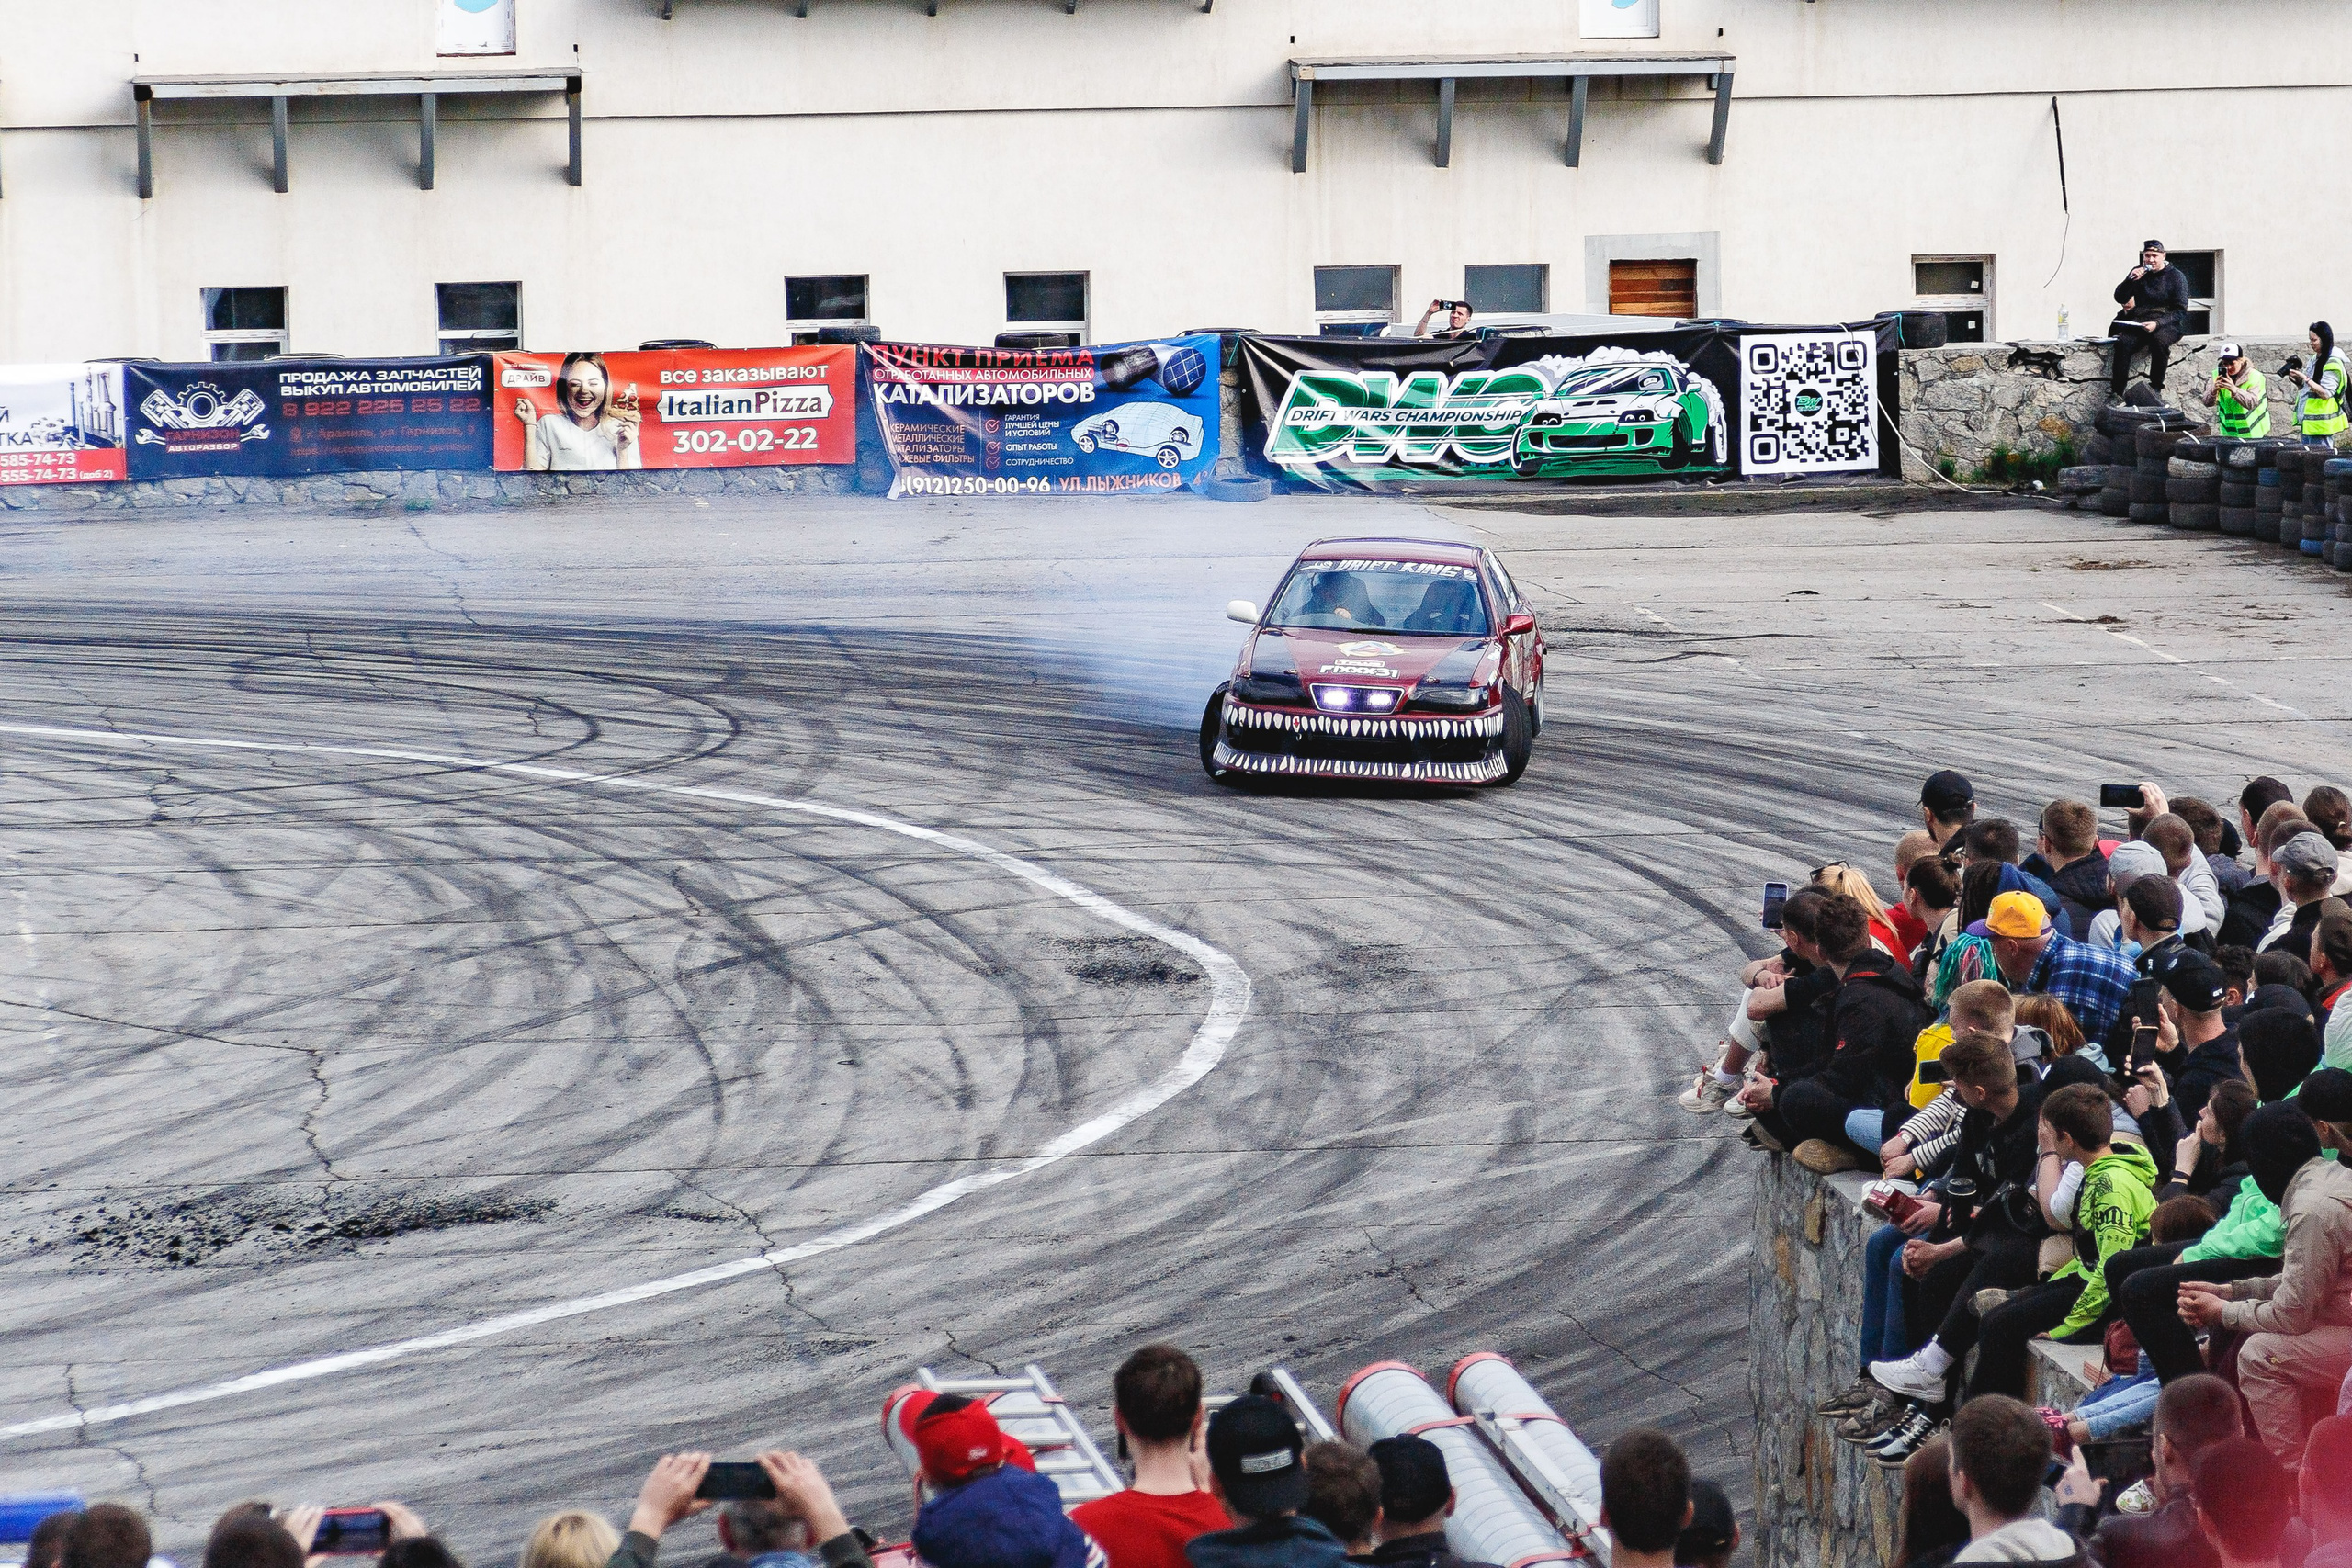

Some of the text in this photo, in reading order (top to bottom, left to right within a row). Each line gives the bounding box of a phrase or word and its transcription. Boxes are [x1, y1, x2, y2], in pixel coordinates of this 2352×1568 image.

[872, 345, 965, 367] ПУНКТ
[279, 366, 482, 384] ПРОДАЖА ЗАПЧАСТЕЙ
[508, 373, 546, 384] ДРАЙВ
[660, 365, 829, 385] все заказывают
[874, 367, 1092, 381] ОТРАБОТАННЫХ АВТОМОБИЛЬНЫХ
[280, 378, 481, 397] ВЫКУП АВТОМОБИЛЕЙ
[873, 382, 1096, 405] КАТАЛИЗАТОРОВ
[304, 401, 351, 416] 922
[357, 399, 405, 414] 225
[411, 398, 443, 412] 25
[448, 397, 481, 412] 22
[667, 390, 822, 416] ItalianPizza
[1290, 410, 1522, 423] DRIFT WARS CHAMPIONSHIP
[889, 423, 966, 434] КЕРАМИЧЕСКИЕ
[1004, 421, 1060, 430] ЛУЧШЕЙ ЦЕНЫ
[1012, 428, 1051, 437] УСЛОВИЙ
[672, 426, 818, 454] 302-02-22
[168, 443, 238, 452] АВТОРАЗБОР
[1028, 443, 1057, 451] РАБОТЫ
[898, 454, 975, 464] АЖЕВЫЕ ФИЛЬТРЫ
[1005, 457, 1074, 467] СОТРУДНИЧЕСТВО
[1335, 559, 1399, 571] DRIFT
